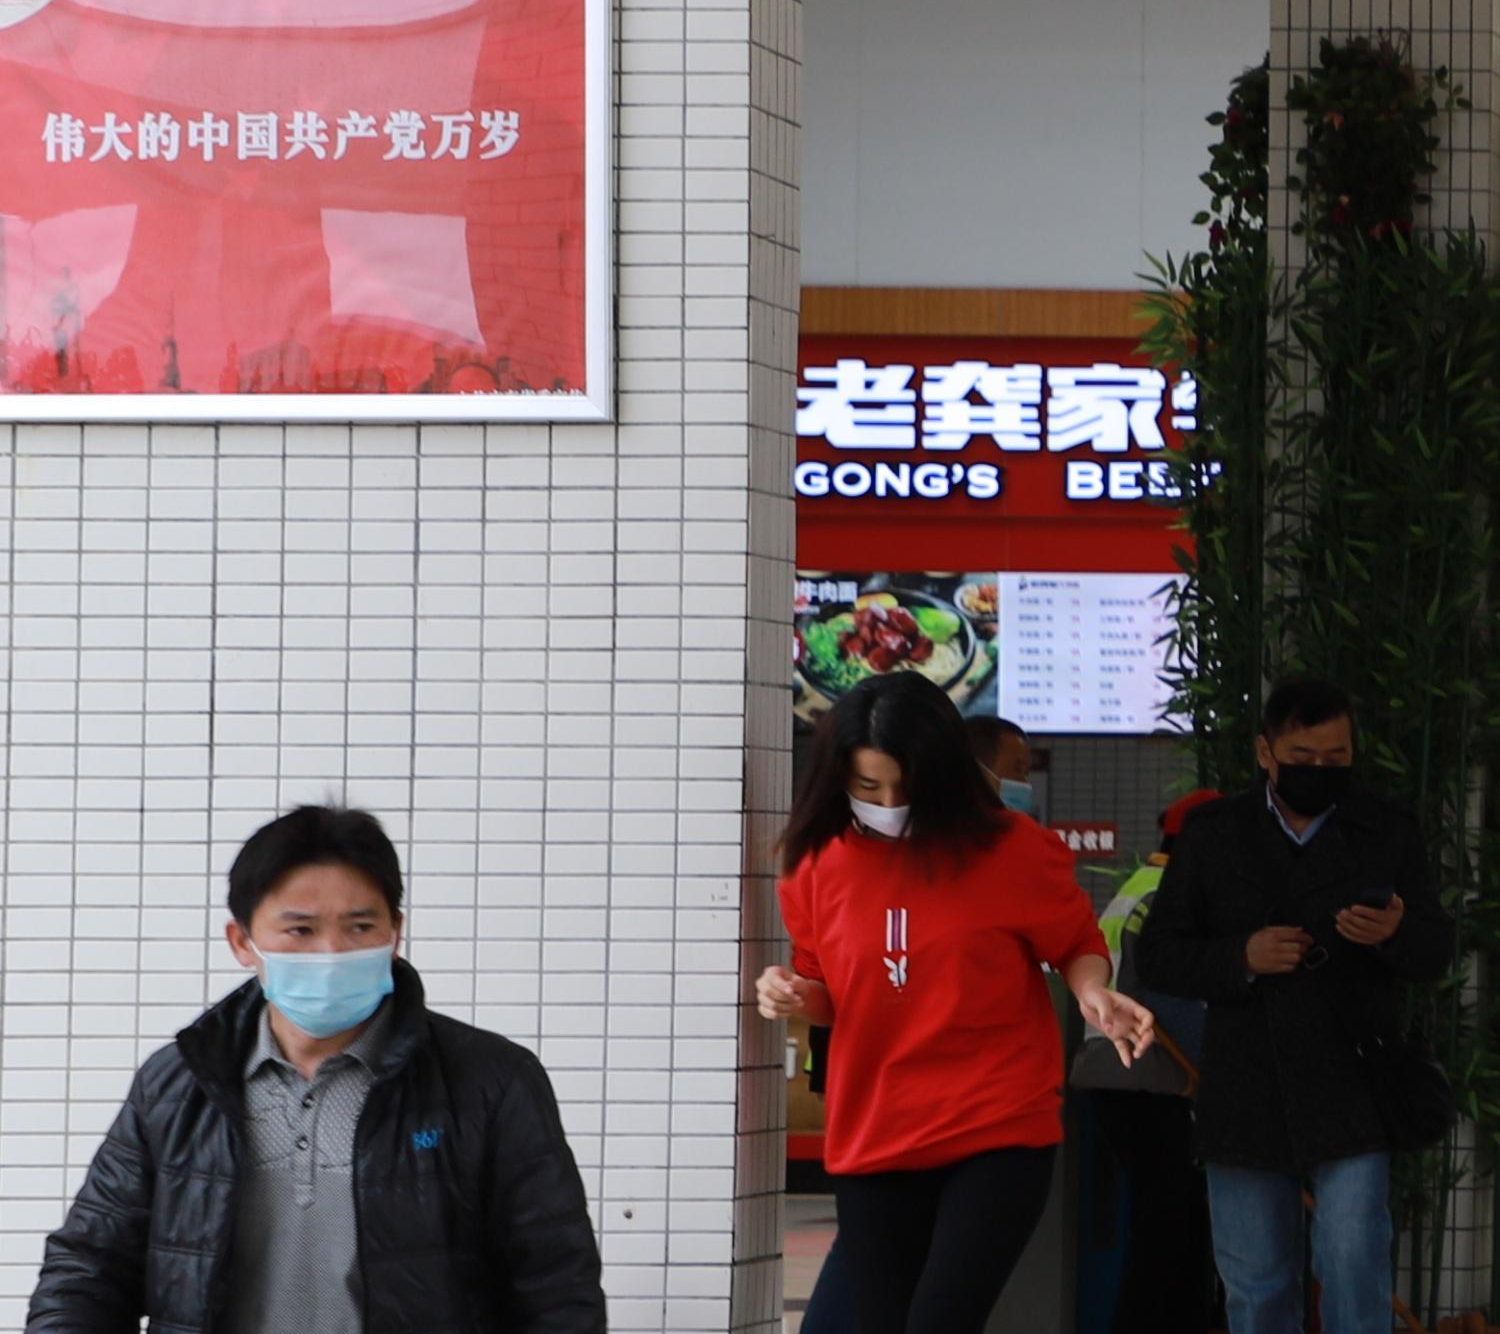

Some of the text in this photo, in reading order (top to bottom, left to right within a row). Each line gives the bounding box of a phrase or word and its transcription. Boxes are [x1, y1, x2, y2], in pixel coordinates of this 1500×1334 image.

[41, 111, 521, 163] 伟大的中国共产党万岁
